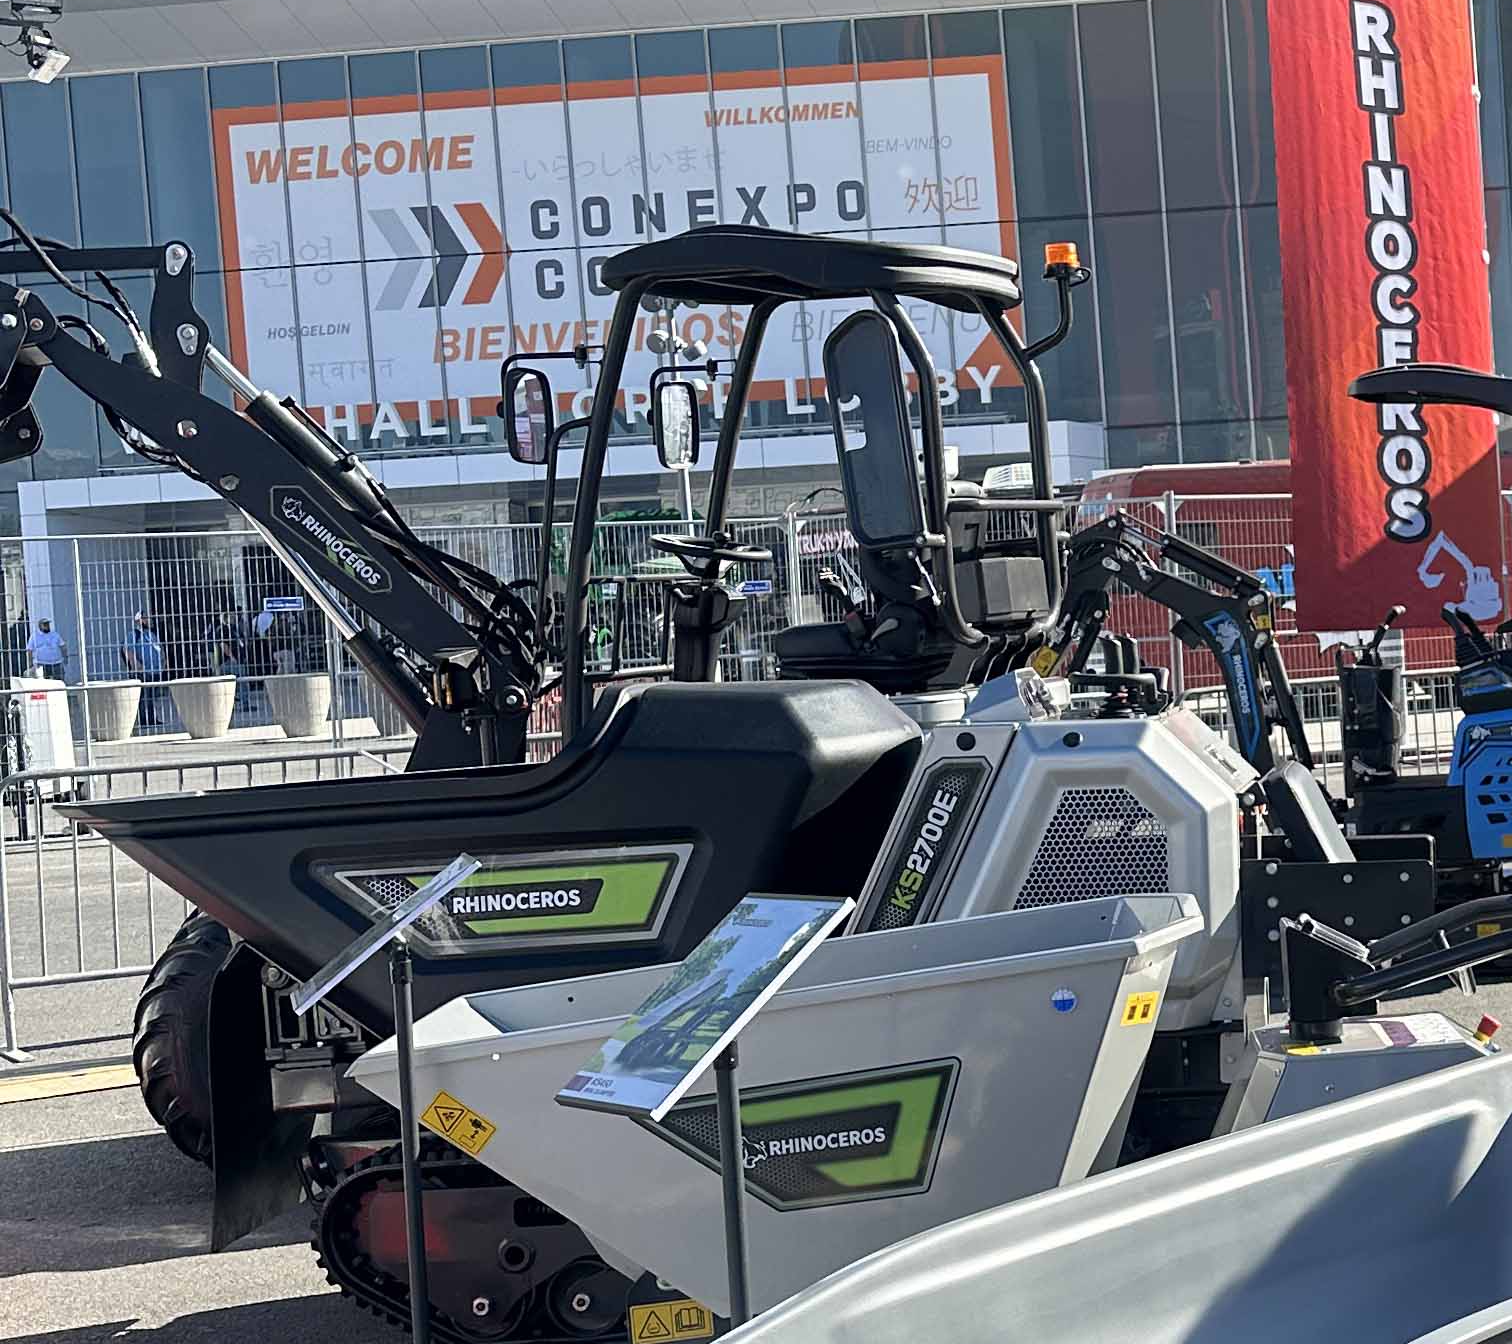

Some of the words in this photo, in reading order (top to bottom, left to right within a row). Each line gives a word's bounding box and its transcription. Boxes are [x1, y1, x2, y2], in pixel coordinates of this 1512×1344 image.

[704, 101, 863, 128] WILLKOMMEN
[245, 135, 475, 185] WELCOME
[864, 136, 952, 154] BEM-VINDO
[530, 179, 867, 240] CONEXPO
[903, 175, 982, 214] 欢迎
[1353, 2, 1430, 540] RHINOCEROS
[324, 397, 488, 441] HALL
[300, 513, 382, 586] RHINOCEROS
[1232, 654, 1251, 715] RHINOCEROS
[889, 789, 959, 911] KS2700E
[452, 887, 581, 915] RHINOCEROS
[768, 1125, 886, 1157] RHINOCEROS
